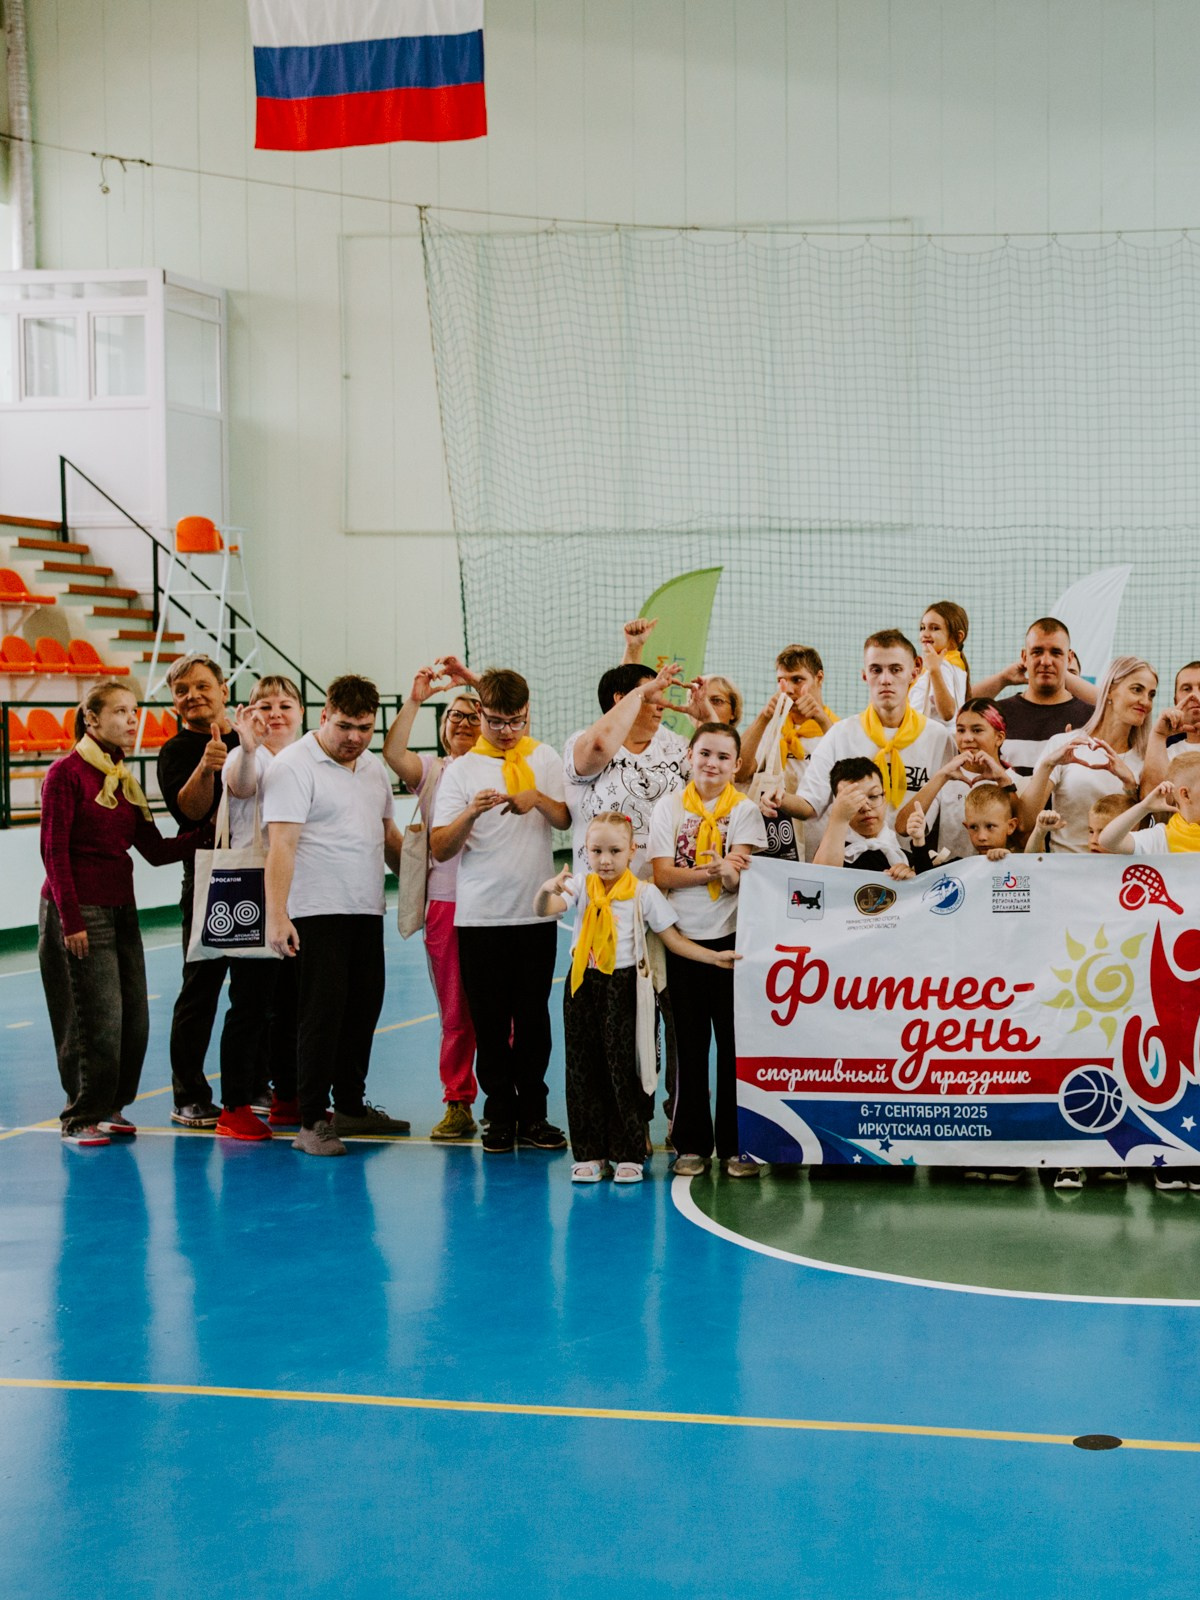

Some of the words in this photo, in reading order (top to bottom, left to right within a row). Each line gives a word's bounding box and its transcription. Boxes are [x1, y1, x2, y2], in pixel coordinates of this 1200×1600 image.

[207, 900, 260, 936] 80
[765, 943, 1036, 1027] Фитнес-
[900, 1018, 1042, 1086] день
[756, 1059, 889, 1092] спортивный
[930, 1070, 1032, 1095] праздник
[858, 1122, 931, 1136] ИРКУТСКАЯ
[934, 1124, 992, 1137] ОБЛАСТЬ
[860, 1104, 882, 1117] 6-7
[884, 1104, 951, 1118] СЕНТЯБРЯ
[953, 1105, 988, 1119] 2025
